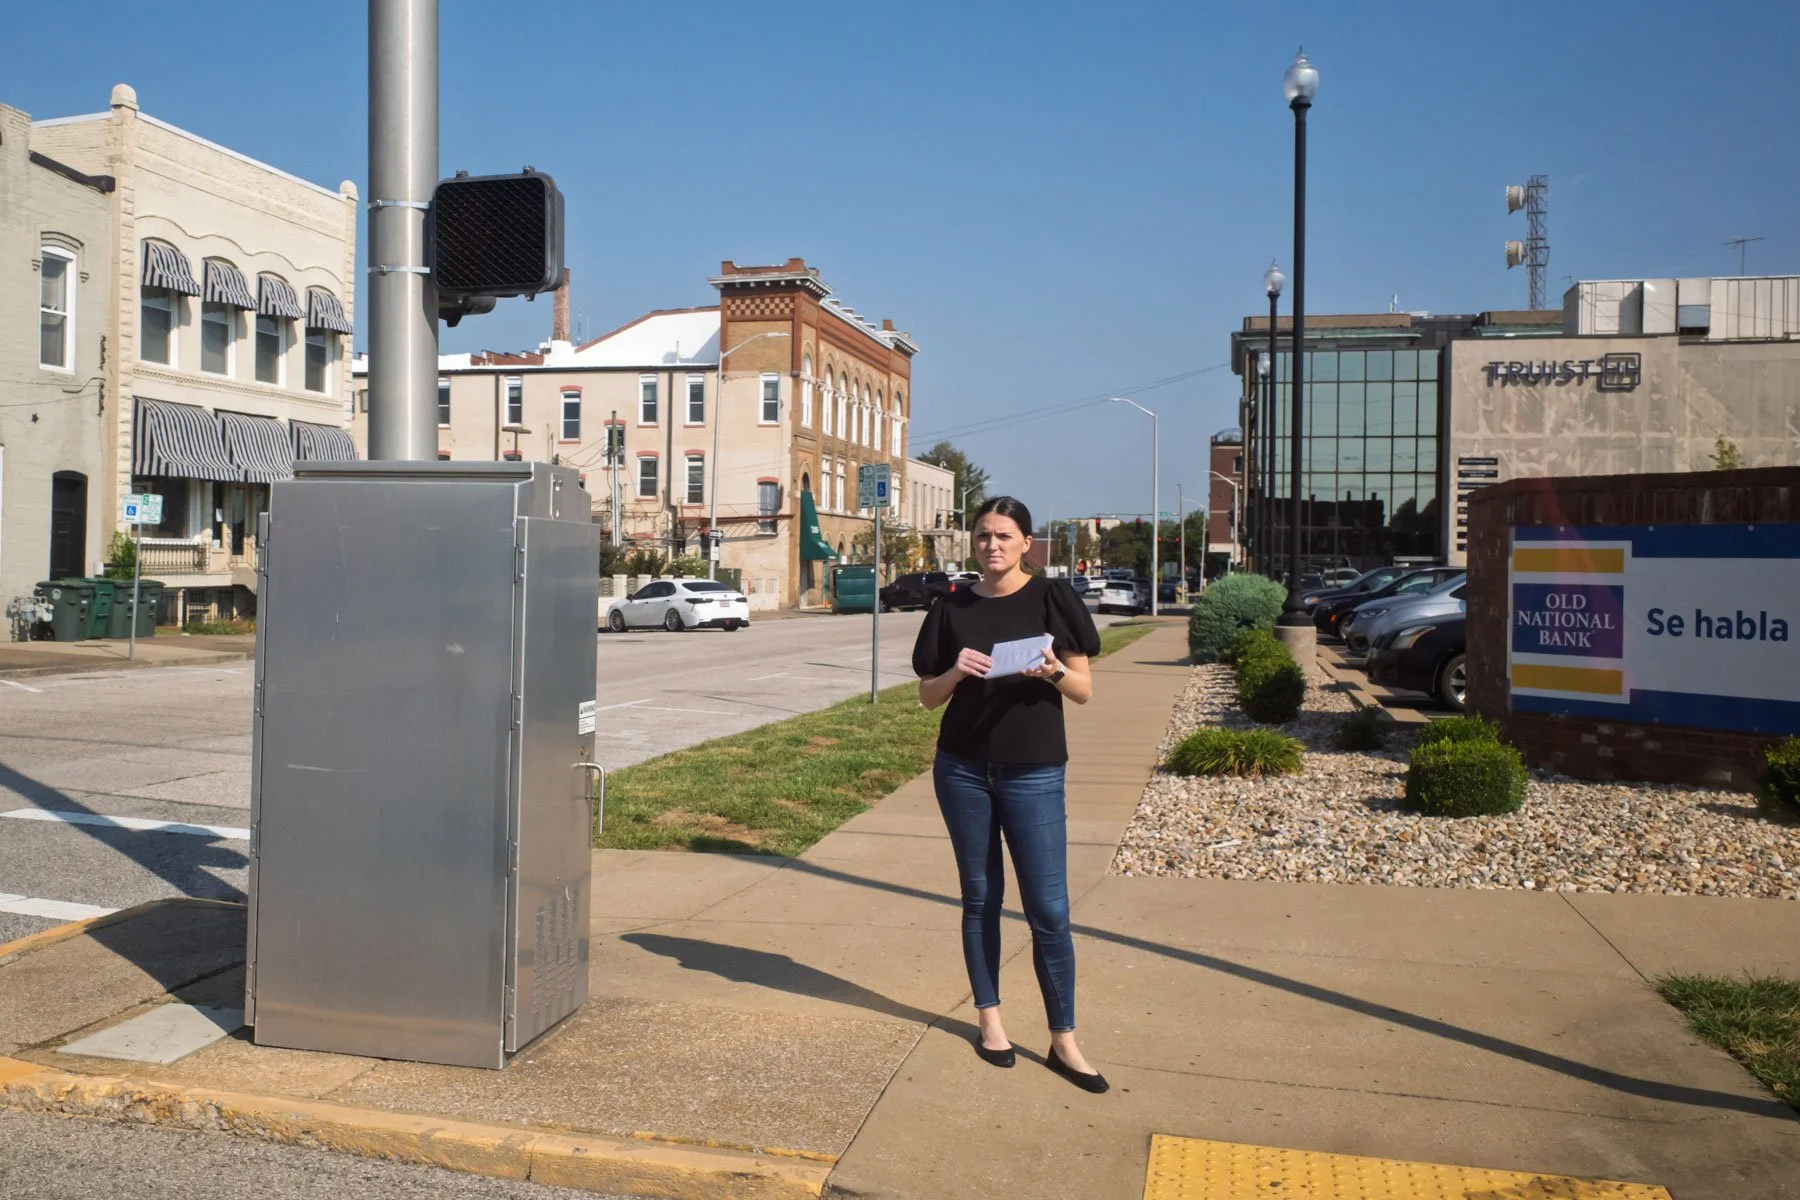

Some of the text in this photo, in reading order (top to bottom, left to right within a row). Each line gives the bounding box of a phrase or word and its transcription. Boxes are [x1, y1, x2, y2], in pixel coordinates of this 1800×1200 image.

[1488, 360, 1595, 381] TRUIST
[1545, 593, 1587, 610] OLD
[1517, 610, 1616, 630] NATIONAL
[1646, 608, 1789, 642] Se habla
[1538, 630, 1592, 648] BANK
